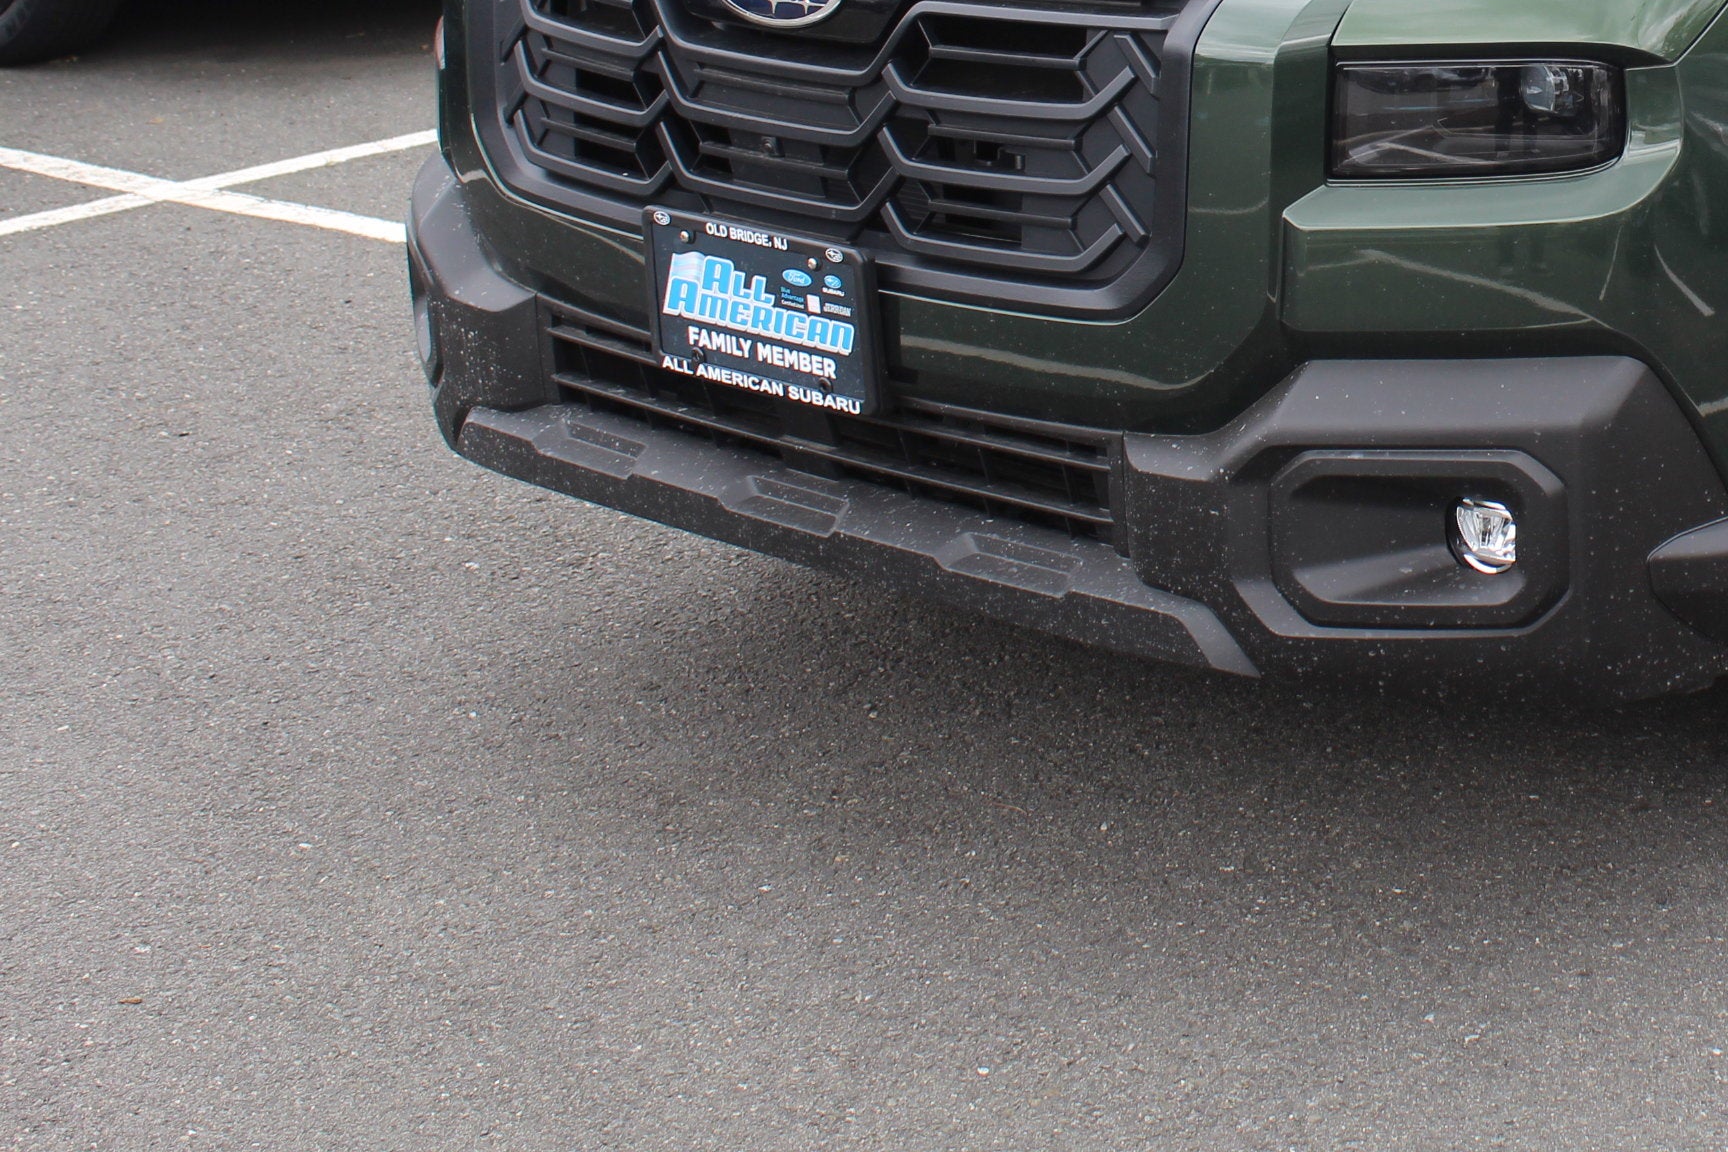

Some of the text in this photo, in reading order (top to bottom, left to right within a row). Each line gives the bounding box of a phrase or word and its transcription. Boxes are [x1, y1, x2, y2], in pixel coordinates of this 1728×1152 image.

[705, 222, 788, 251] OLD BRIDGE, NJ
[662, 277, 855, 356] AMERICAN
[688, 325, 837, 380] FAMILY MEMBER
[662, 355, 861, 415] ALL AMERICAN SUBARU
